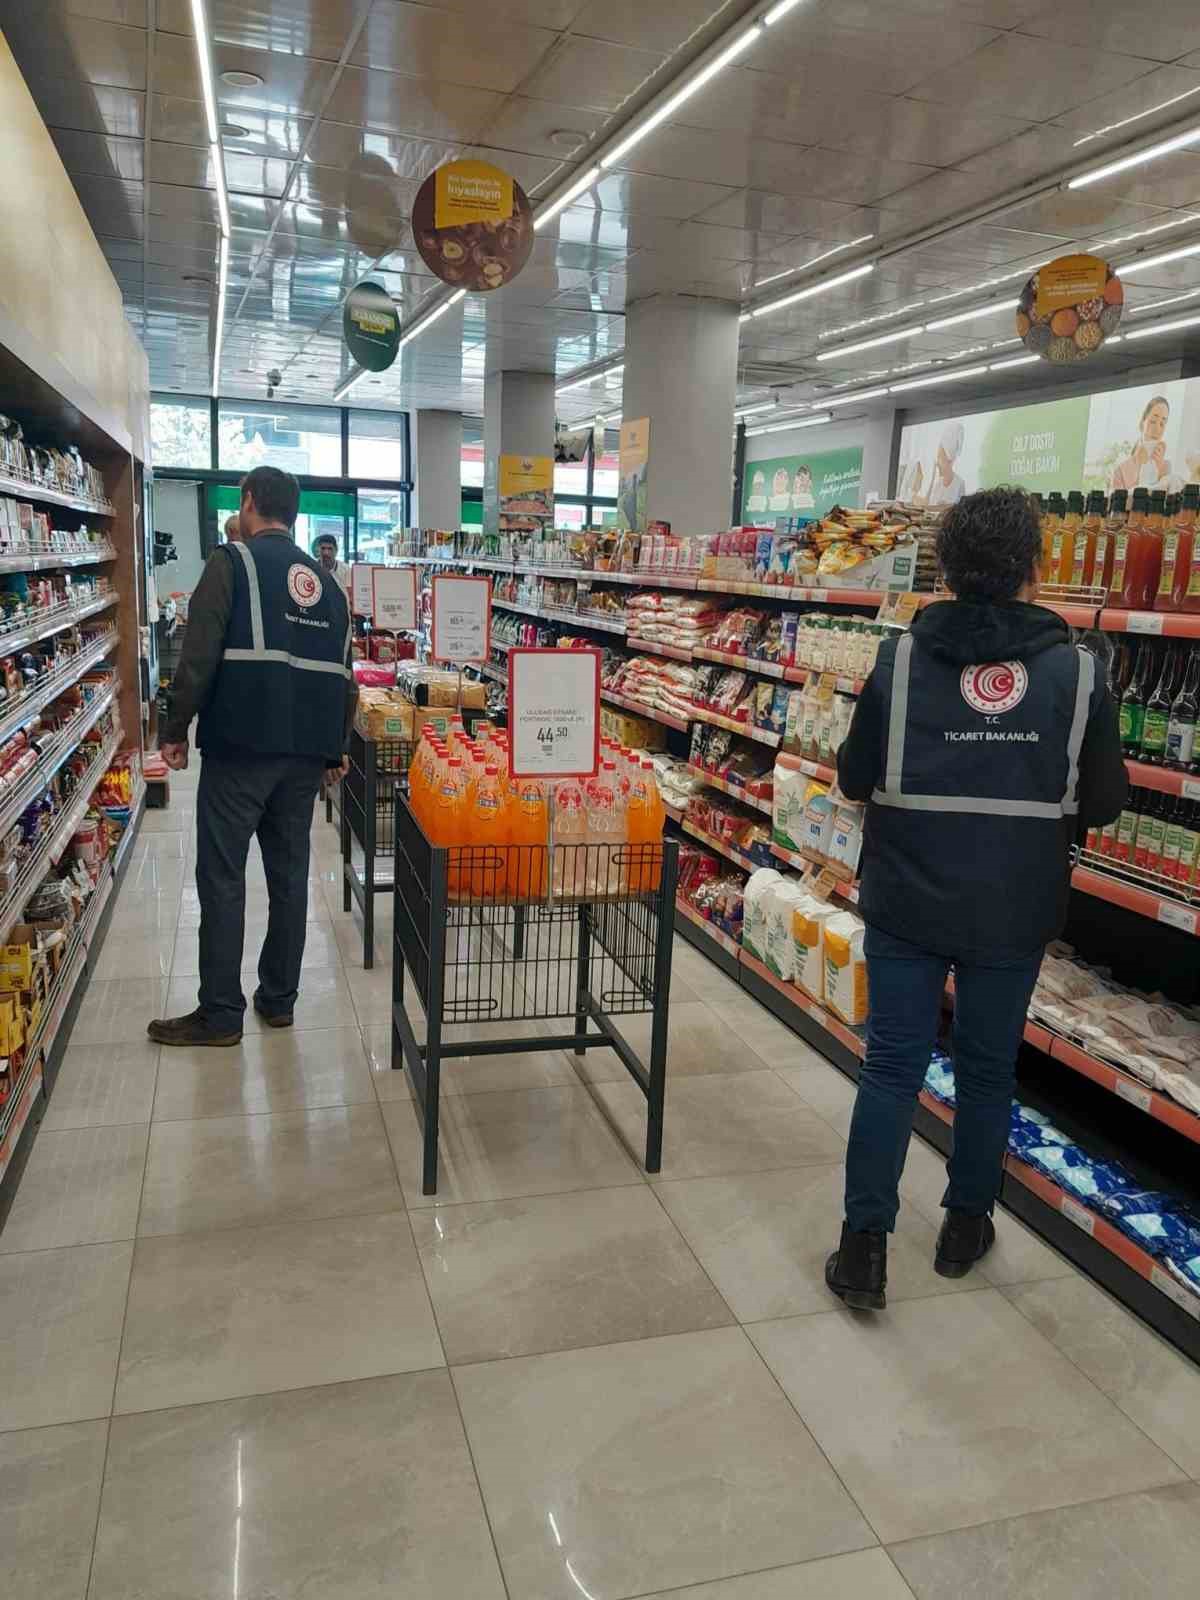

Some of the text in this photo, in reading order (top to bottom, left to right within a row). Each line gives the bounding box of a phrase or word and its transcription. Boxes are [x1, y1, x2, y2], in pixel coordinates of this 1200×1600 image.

[984, 716, 1001, 725] T.C.
[943, 730, 1040, 742] TİCARET BAKANLIĞI
